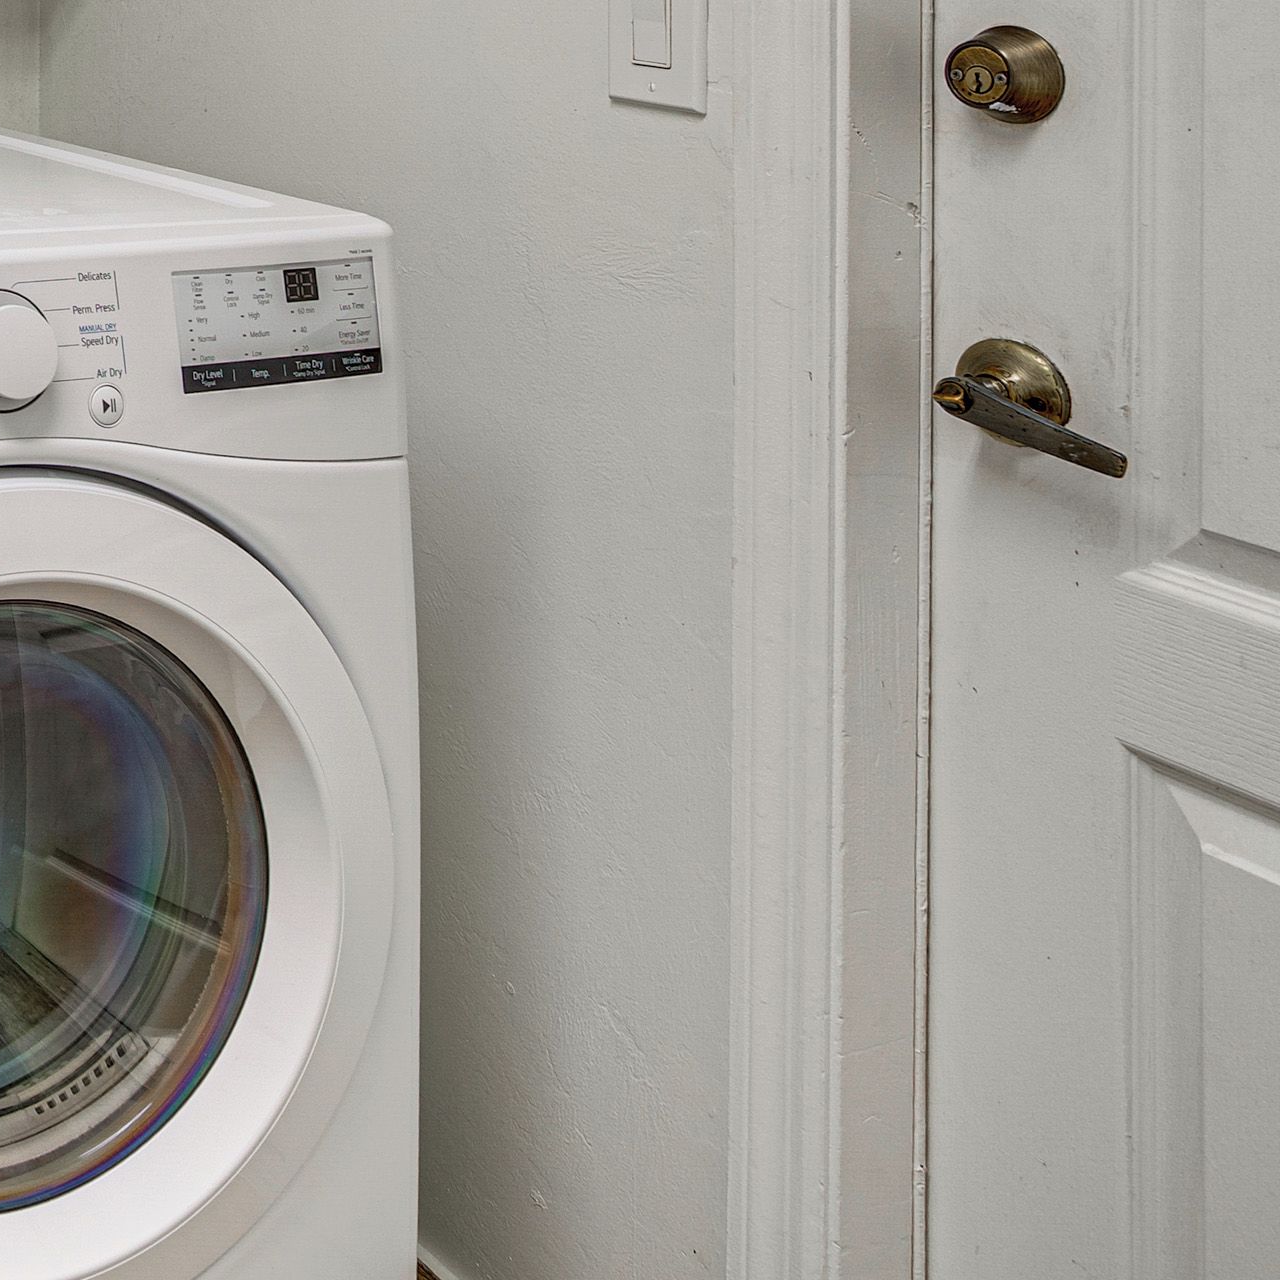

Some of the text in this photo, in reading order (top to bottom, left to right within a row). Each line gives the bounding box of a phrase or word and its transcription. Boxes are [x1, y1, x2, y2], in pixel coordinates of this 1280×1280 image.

[77, 271, 112, 282] Delicates
[72, 303, 116, 315] Perm. Press
[248, 312, 260, 320] High
[78, 322, 117, 333] MANUAL DRY
[338, 329, 371, 339] Energy Saver
[81, 335, 119, 347] Speed Dry
[296, 359, 324, 370] Time Dry
[342, 354, 374, 365] Wrinkle Care
[96, 367, 123, 379] Air Dry
[192, 369, 223, 381] Dry Level
[251, 369, 270, 380] Temp.
